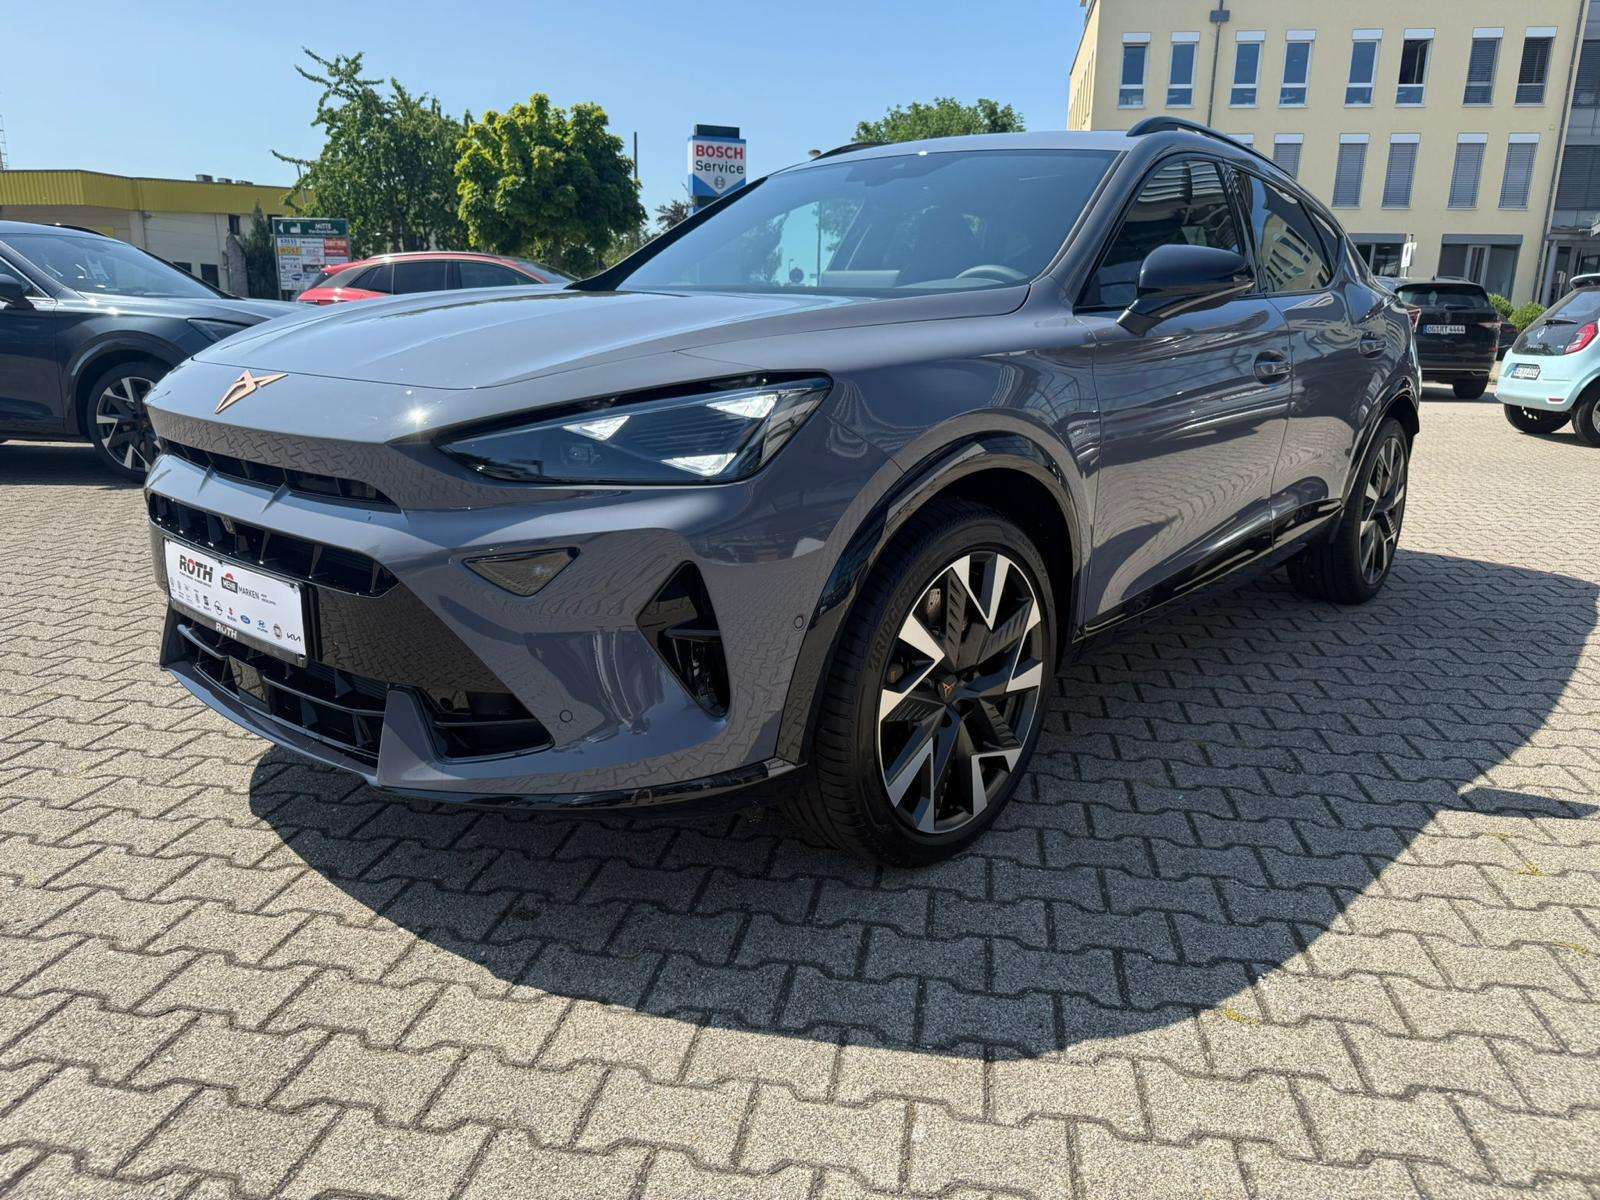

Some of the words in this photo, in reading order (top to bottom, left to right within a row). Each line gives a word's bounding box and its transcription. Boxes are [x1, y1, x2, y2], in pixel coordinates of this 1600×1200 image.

[696, 144, 744, 160] BOSCH
[695, 160, 744, 175] Service
[179, 554, 214, 582] ROTH
[238, 585, 260, 601] MARKEN
[215, 622, 237, 639] ROTH
